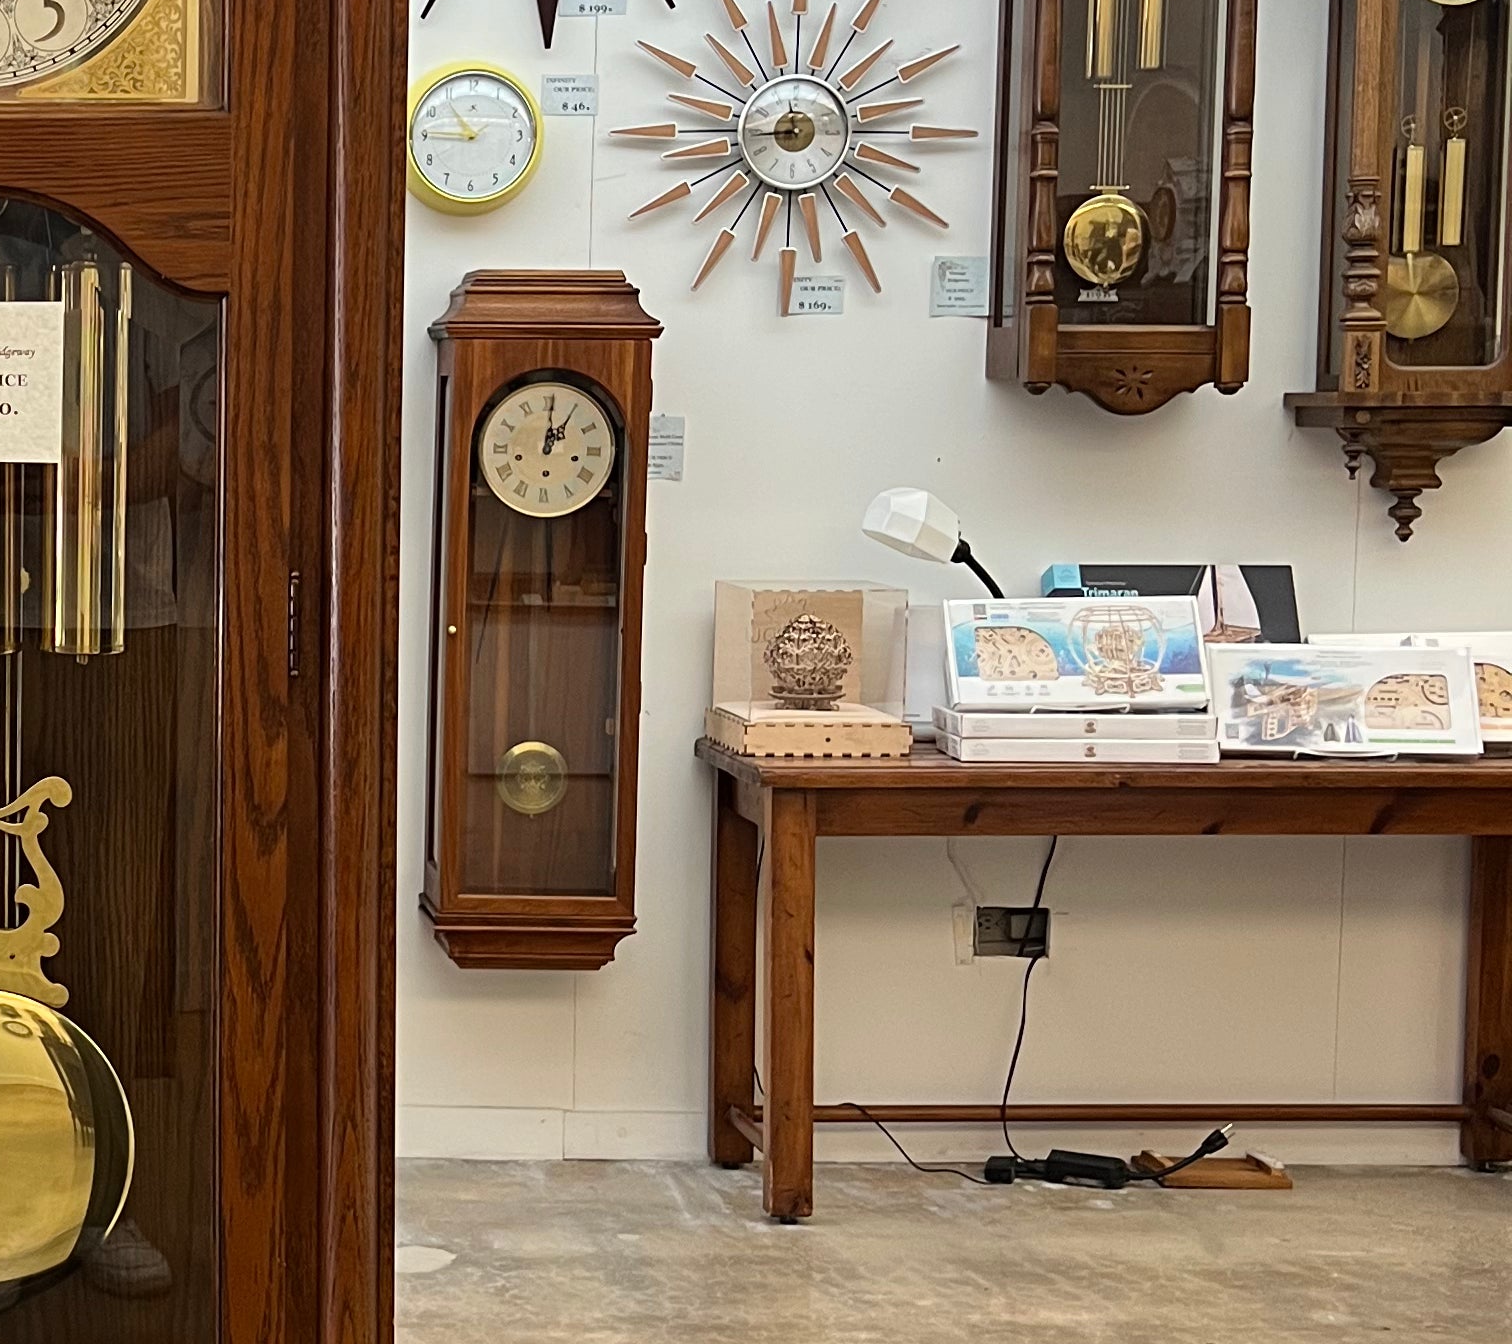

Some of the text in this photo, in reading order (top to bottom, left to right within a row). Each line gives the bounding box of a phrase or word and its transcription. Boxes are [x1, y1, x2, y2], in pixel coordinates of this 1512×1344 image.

[469, 80, 478, 92] 12
[426, 106, 436, 117] 10
[512, 107, 518, 118] 2
[421, 129, 428, 141] 9
[516, 130, 523, 142] 3
[426, 154, 433, 165] 8
[509, 154, 516, 165] 4
[443, 173, 450, 185] 7
[492, 173, 499, 185] 5
[467, 180, 474, 191] 6
